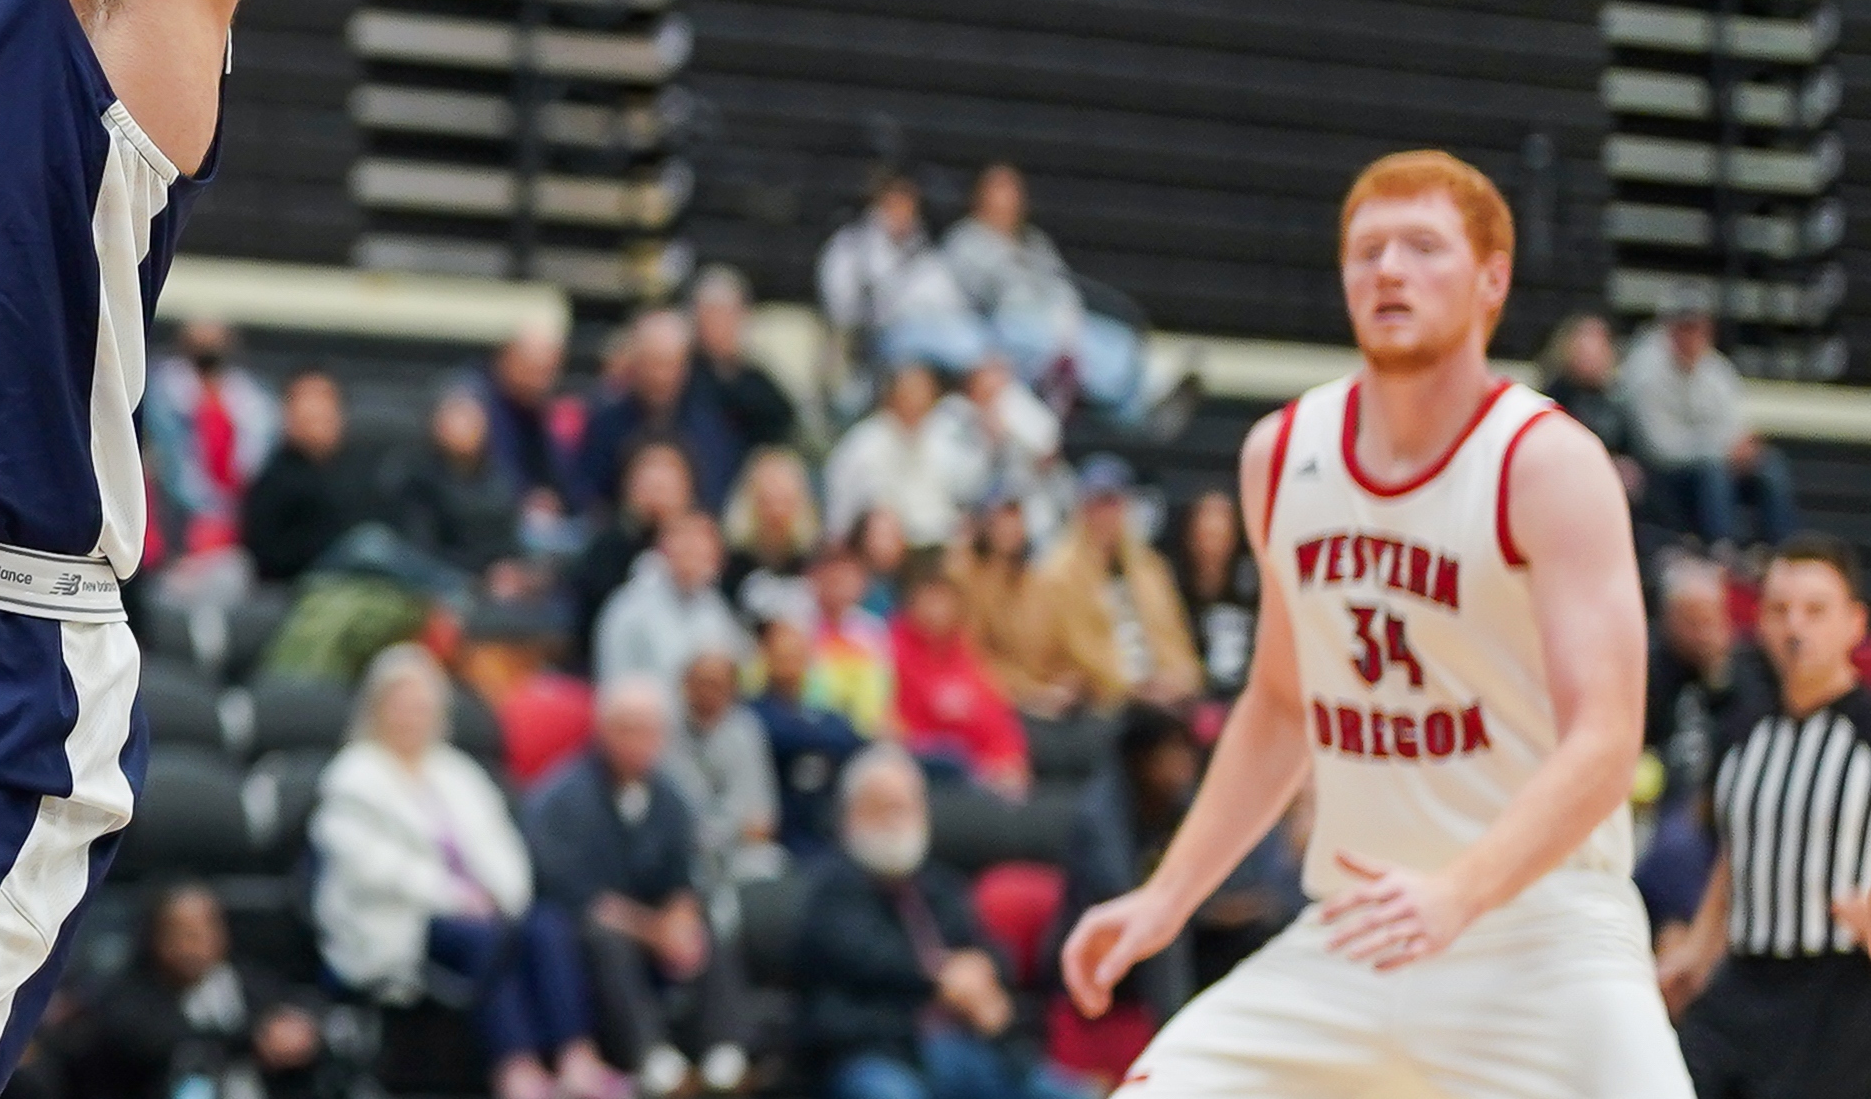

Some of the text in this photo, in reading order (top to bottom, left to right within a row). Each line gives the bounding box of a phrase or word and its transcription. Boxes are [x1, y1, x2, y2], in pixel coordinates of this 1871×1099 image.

[1295, 534, 1460, 610] WESTERN
[1349, 606, 1424, 687] 34
[1312, 698, 1490, 758] OREGON
